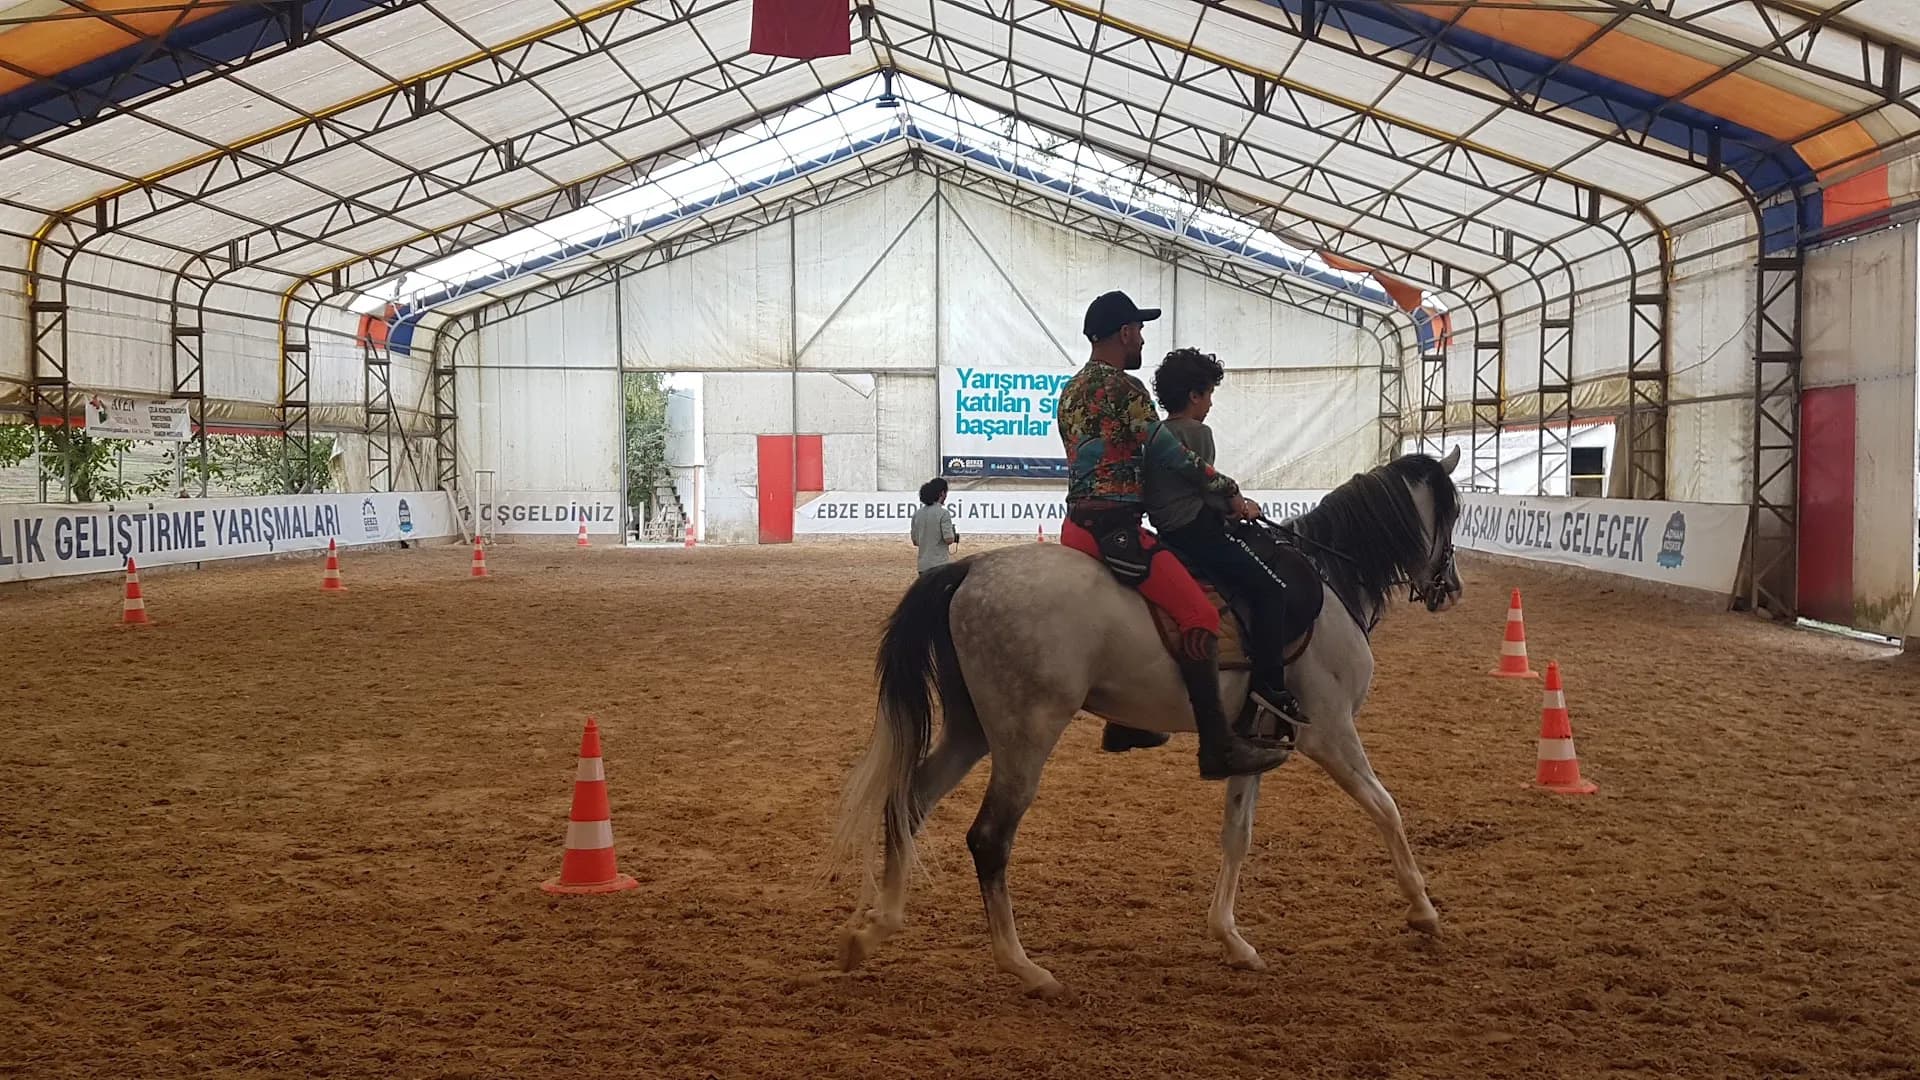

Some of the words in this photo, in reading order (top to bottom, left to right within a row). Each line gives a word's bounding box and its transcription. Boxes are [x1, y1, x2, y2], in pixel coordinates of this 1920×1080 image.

[956, 367, 1073, 396] Yarışmaya
[956, 390, 1031, 413] katılan
[956, 413, 1052, 440] başarılar
[811, 503, 859, 520] EBZE
[967, 503, 1005, 520] ATLI
[1011, 503, 1069, 520] DAYAN
[0, 517, 46, 566] LIK
[55, 502, 206, 568] GELİŞTİRME
[213, 504, 341, 552] YARIŞMALARI
[1504, 501, 1553, 549] GÜZEL
[1559, 511, 1649, 562] GELECEK
